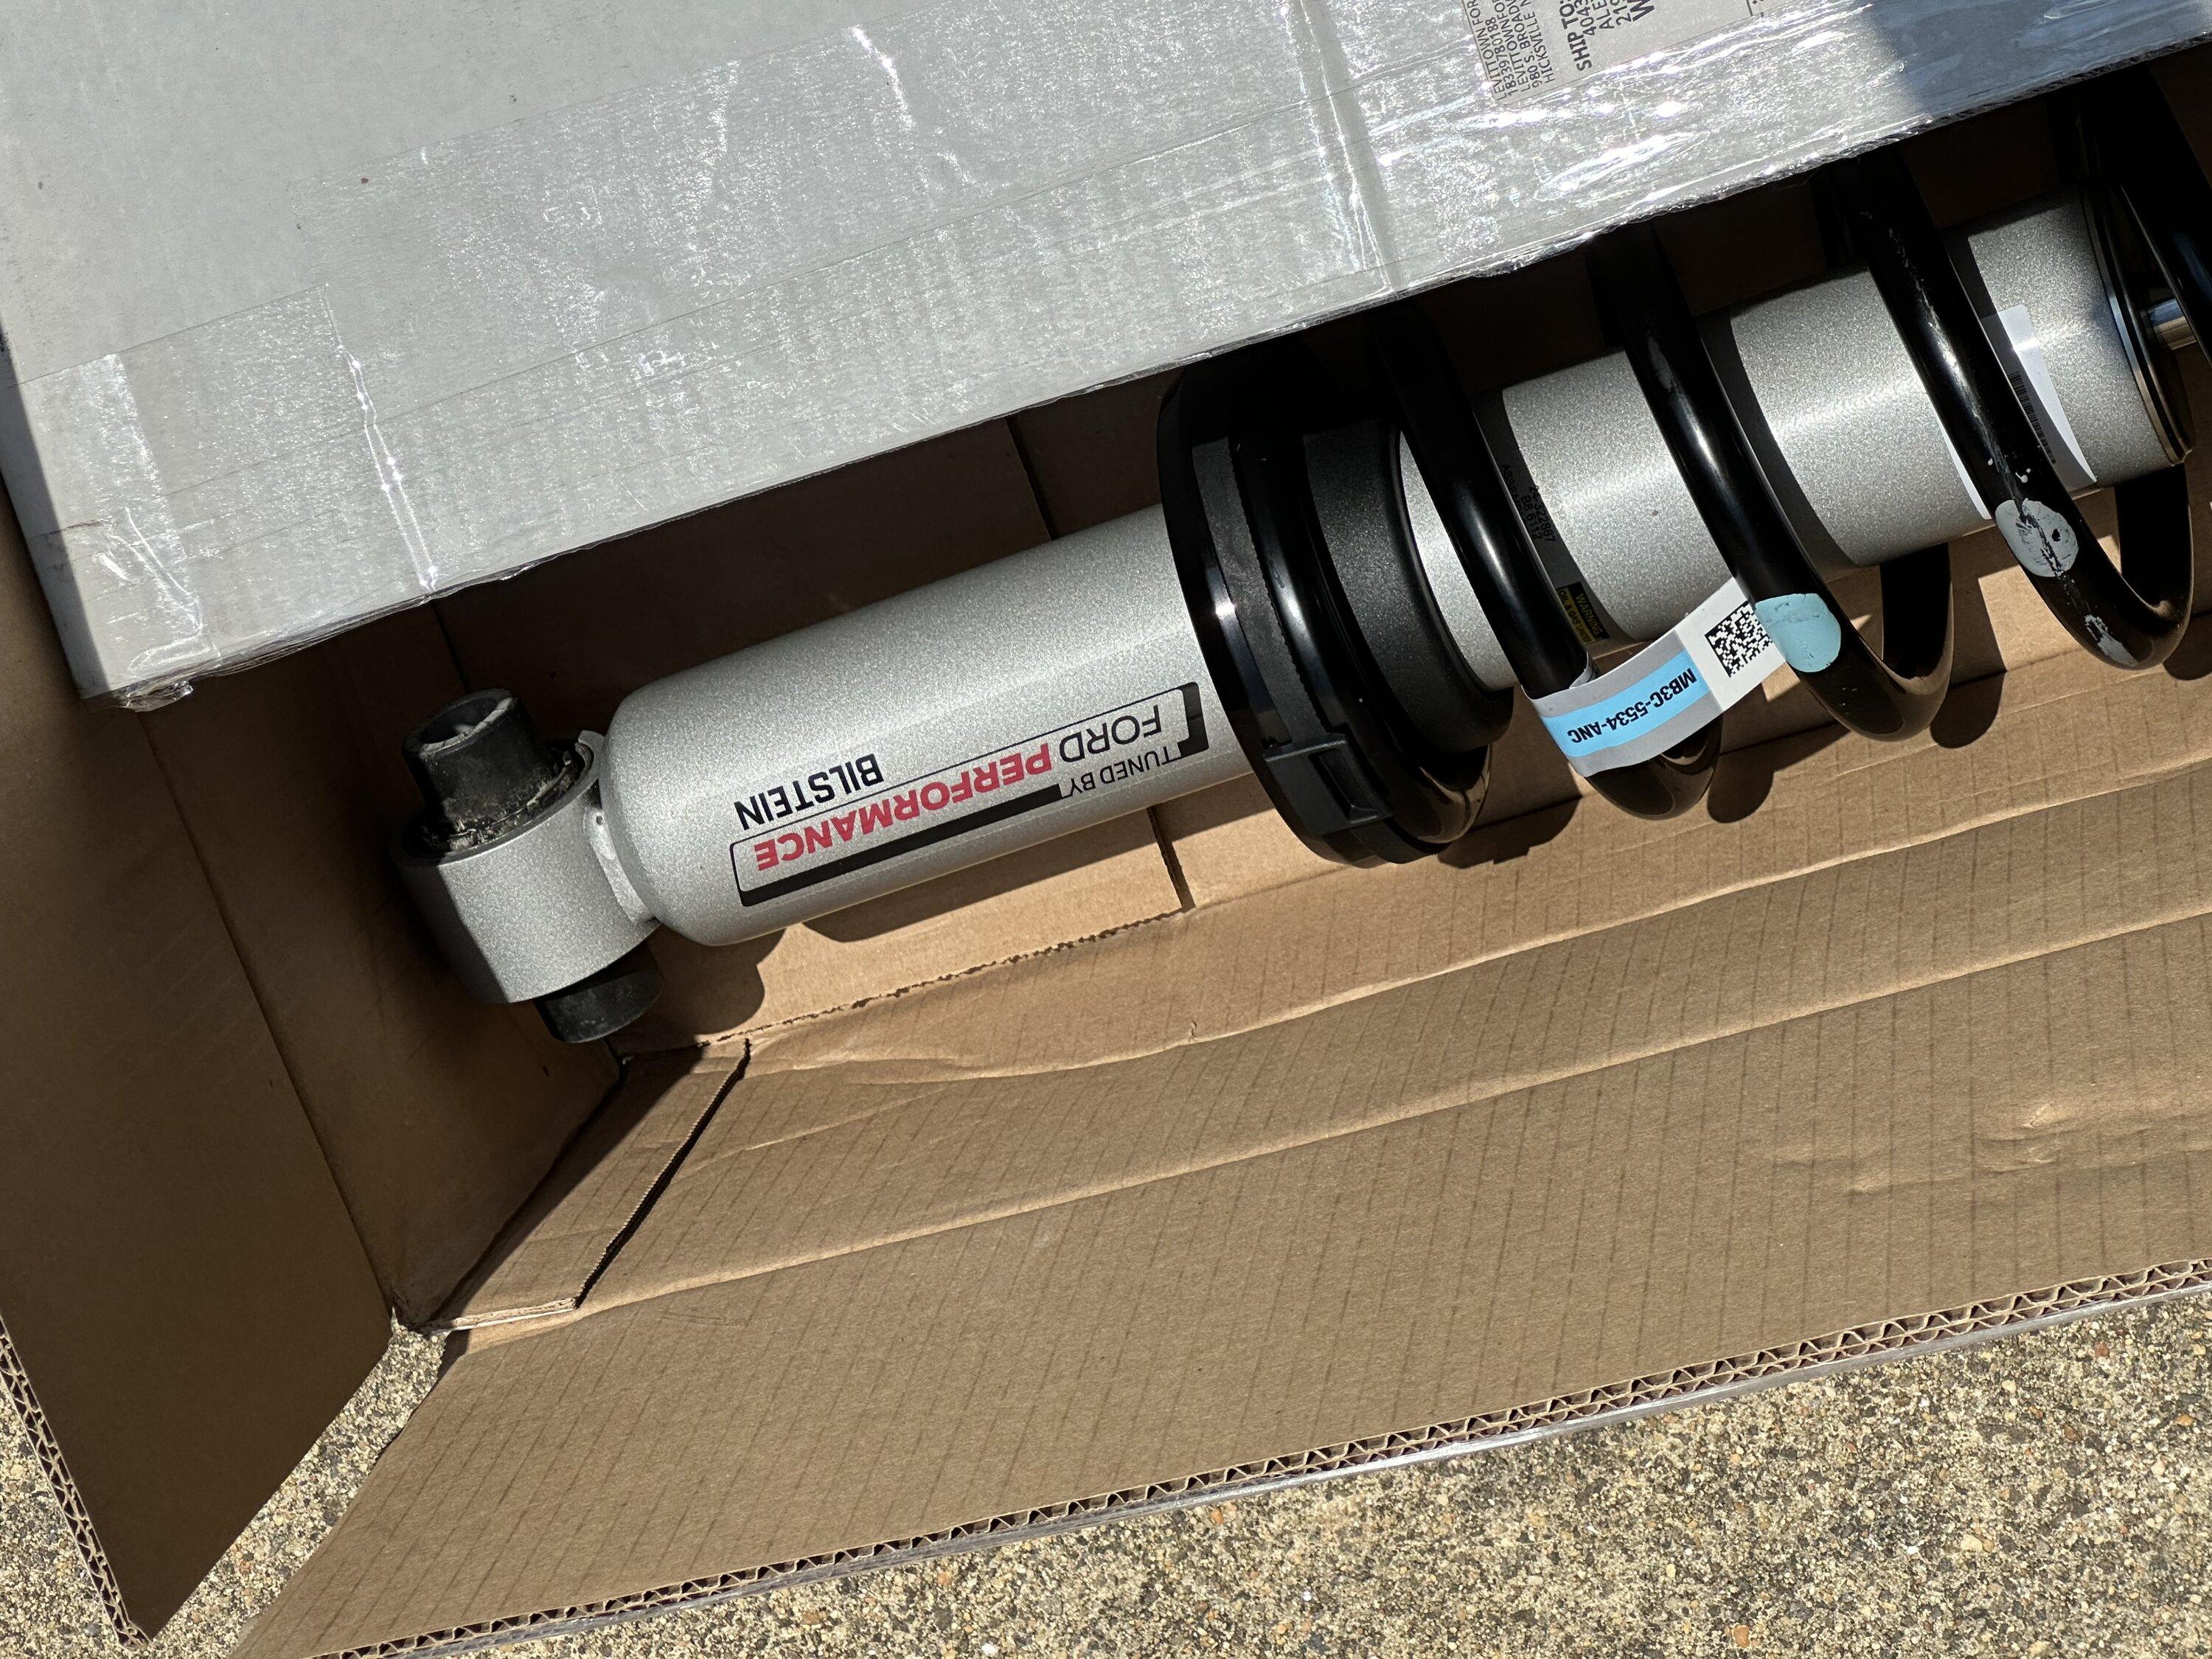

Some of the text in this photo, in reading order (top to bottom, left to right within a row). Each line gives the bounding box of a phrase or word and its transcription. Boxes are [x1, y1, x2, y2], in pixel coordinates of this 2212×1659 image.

[1492, 0, 1531, 92] LEVITTOWNFO
[1523, 11, 1556, 83] HICKSVILLE
[1559, 0, 1593, 72] SHIP TO:
[1591, 0, 1615, 29] ALE
[1475, 27, 1507, 101] LEVITTOWN
[1485, 17, 1519, 97] 18339780188
[1524, 51, 1535, 63] S.
[1527, 65, 1543, 88] 980
[1574, 593, 1603, 635] WARNING
[1567, 667, 1697, 744] MB3C-5534-ANC
[733, 753, 885, 831] BILSTEIN
[753, 704, 1163, 872] FORD PERFORMANCE
[1066, 745, 1180, 799] TUNED BY
